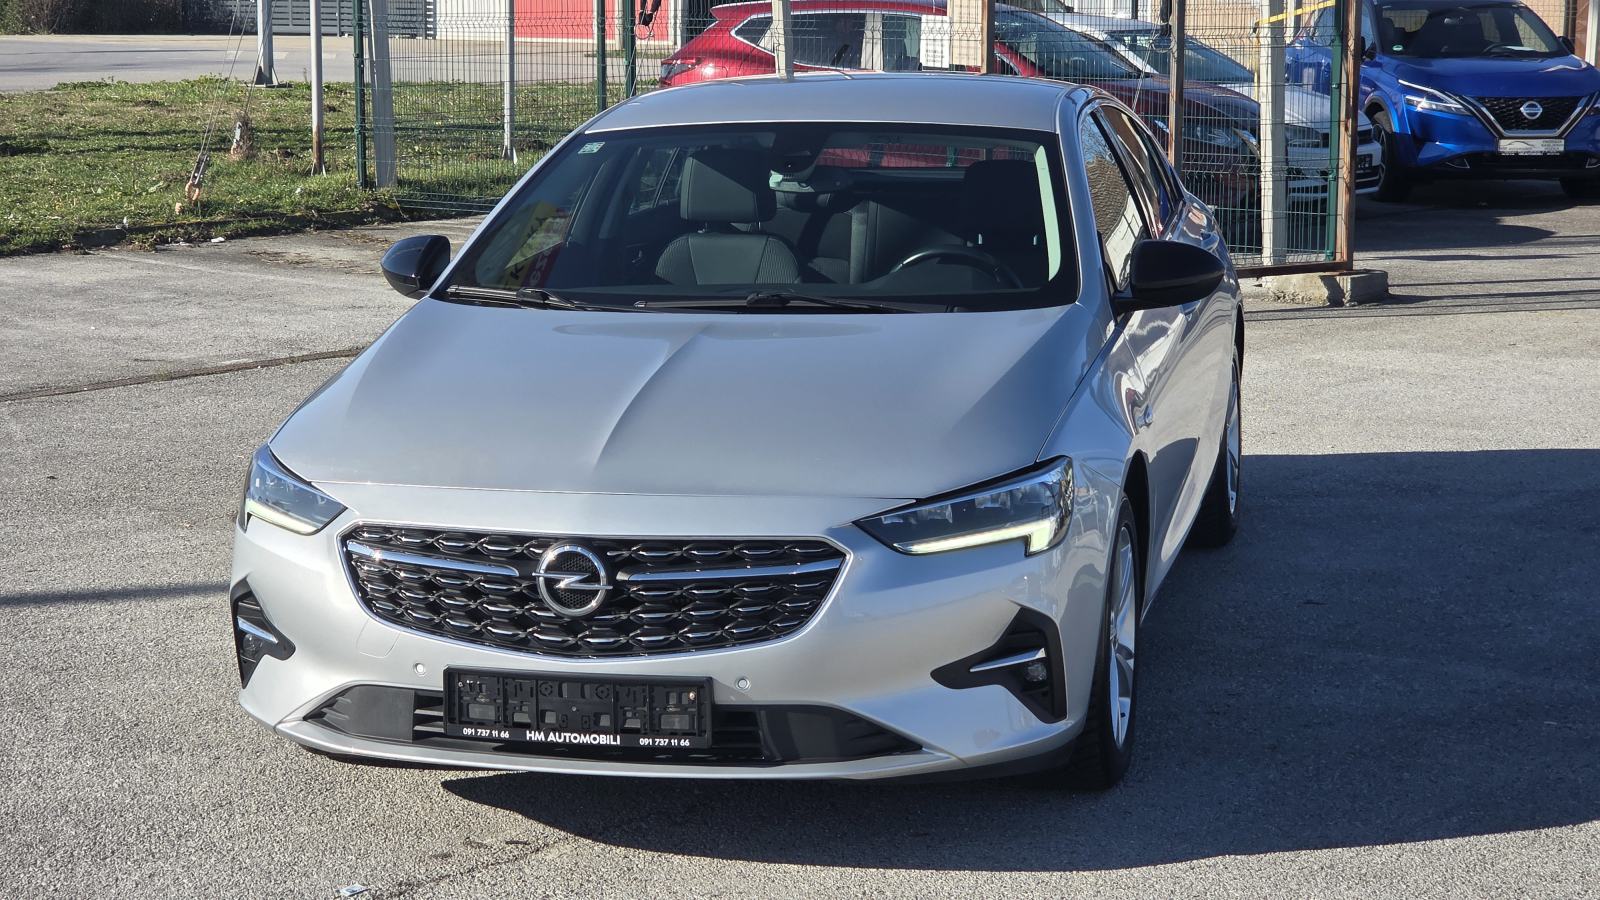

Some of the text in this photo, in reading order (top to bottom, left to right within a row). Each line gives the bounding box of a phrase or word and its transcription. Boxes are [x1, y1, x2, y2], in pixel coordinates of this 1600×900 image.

[462, 727, 510, 739] 091 737 11 66
[526, 730, 621, 745] HM AUTOMOBILI
[639, 738, 690, 747] 091 737 11 66
